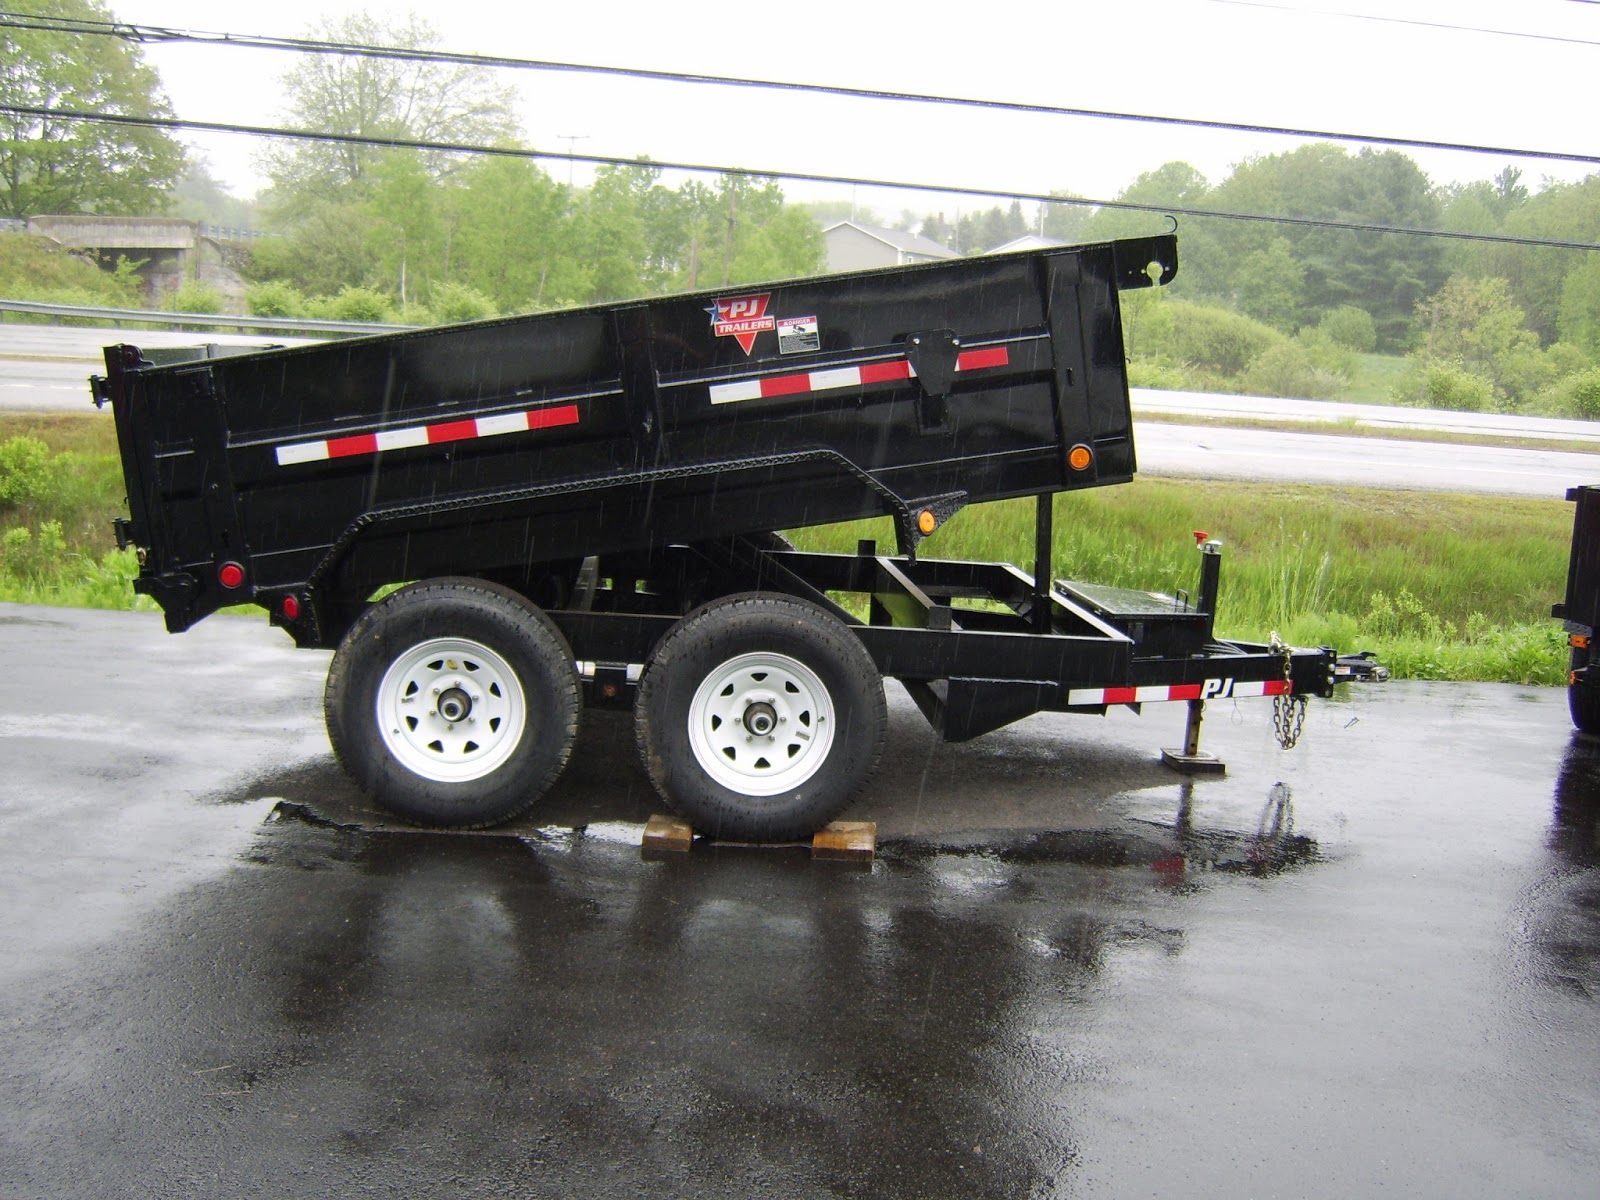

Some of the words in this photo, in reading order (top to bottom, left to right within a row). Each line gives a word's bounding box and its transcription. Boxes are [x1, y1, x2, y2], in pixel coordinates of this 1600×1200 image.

[729, 299, 758, 318] PJ
[719, 319, 773, 333] TRAILERS
[788, 318, 811, 326] DANGER
[1200, 677, 1234, 699] PJ
